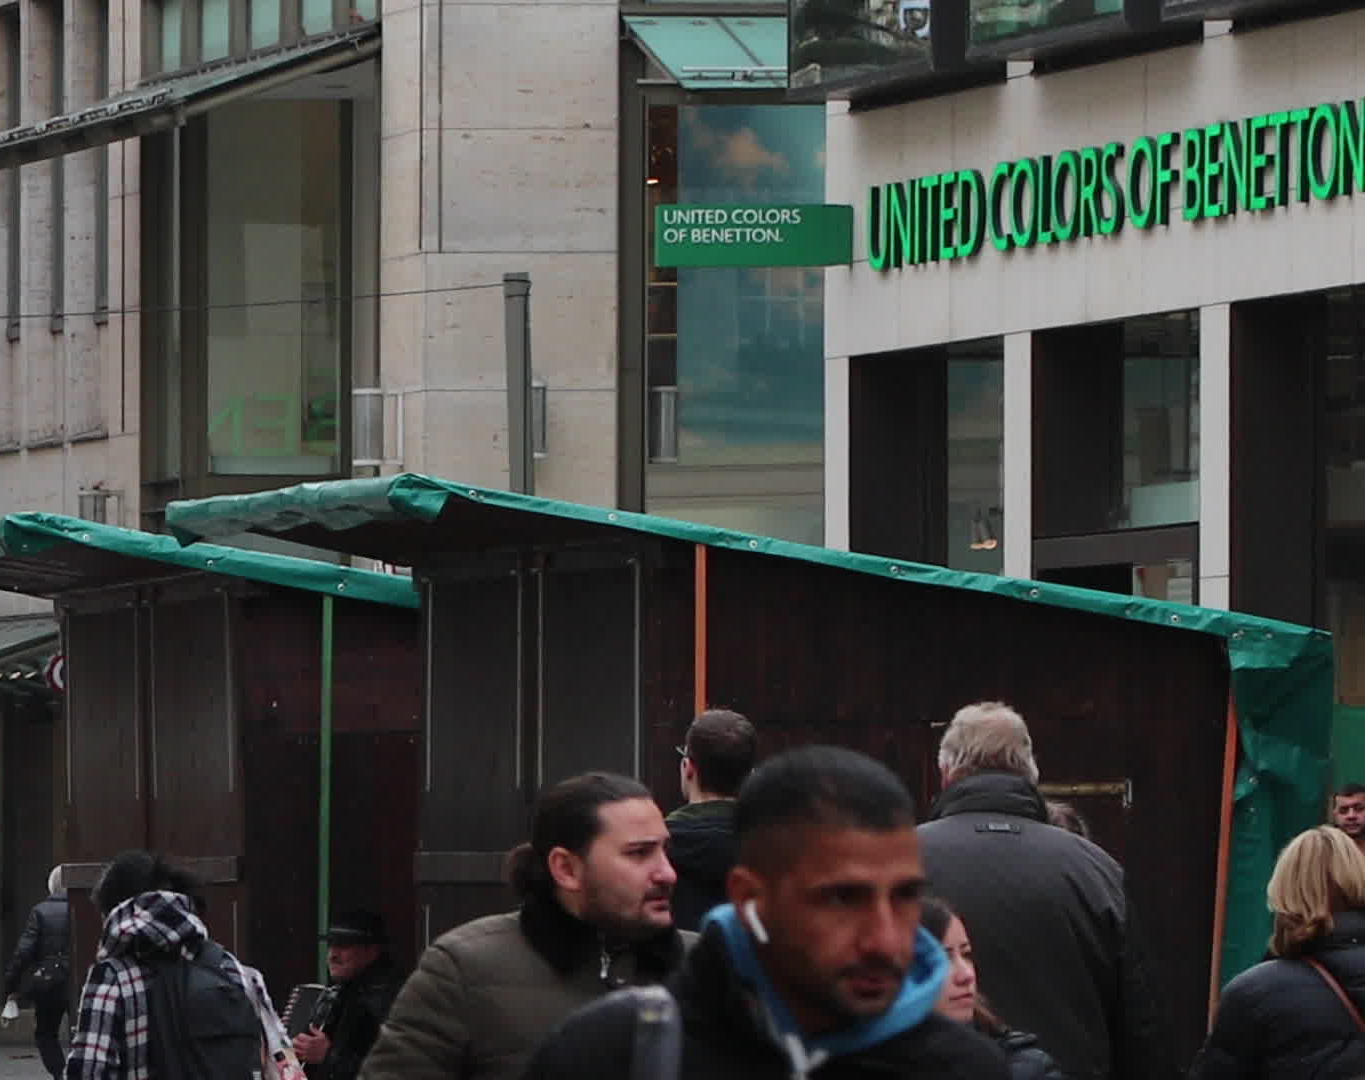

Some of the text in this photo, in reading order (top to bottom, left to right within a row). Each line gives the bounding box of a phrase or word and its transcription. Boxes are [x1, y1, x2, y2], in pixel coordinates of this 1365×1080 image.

[868, 97, 1365, 271] UNITED COLORS OF BENETTON
[663, 208, 801, 225] UNITED COLORS
[663, 228, 688, 244] OF
